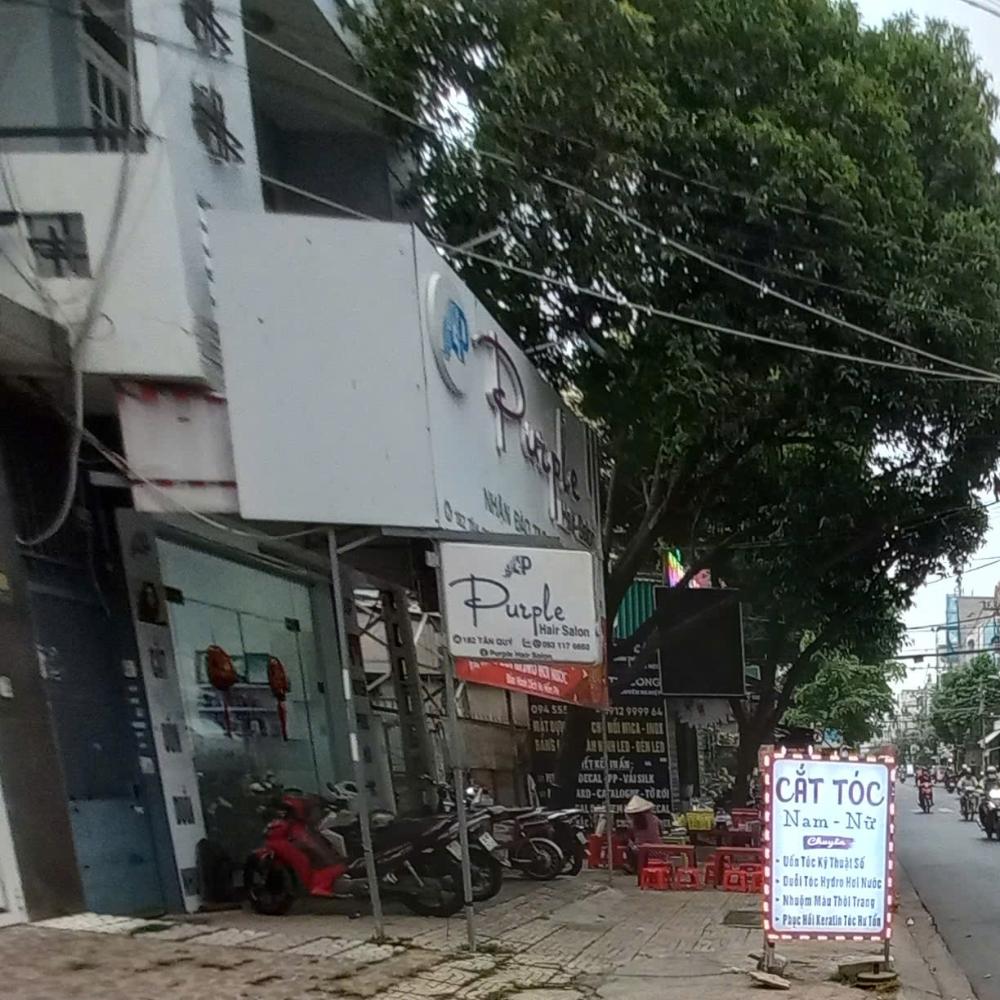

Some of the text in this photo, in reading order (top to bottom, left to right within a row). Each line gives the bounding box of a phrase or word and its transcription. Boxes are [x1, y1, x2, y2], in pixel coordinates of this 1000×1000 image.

[448, 574, 566, 637] Purple
[539, 623, 590, 638] Hair Salon
[478, 635, 494, 646] TÂN
[626, 706, 649, 716] 9999
[651, 706, 663, 717] 64
[578, 773, 602, 783] DECAL
[775, 763, 885, 806] CẮT TÓC
[576, 788, 591, 799] ARD
[783, 809, 829, 829] Nam
[845, 812, 877, 830] Nữ
[801, 855, 816, 868] Tóc
[804, 875, 818, 887] Tóc
[820, 876, 844, 889] Hydro
[853, 896, 875, 909] Trang
[816, 914, 842, 926] Keratin
[844, 914, 856, 926] Tóc
